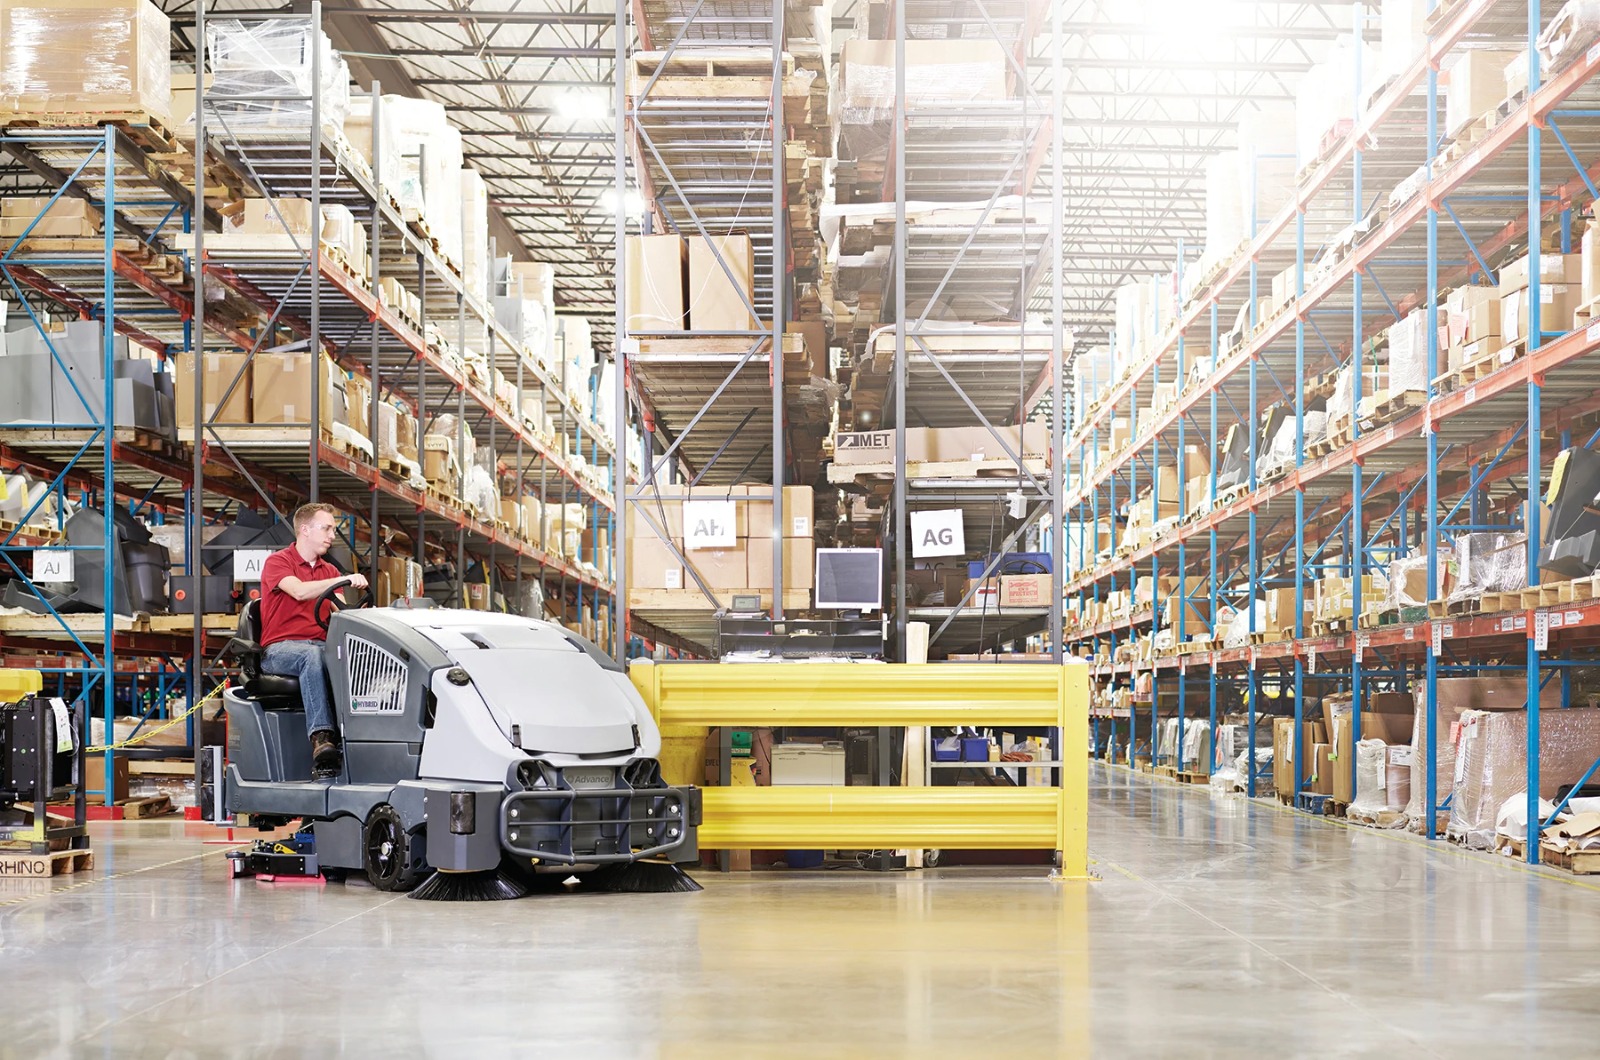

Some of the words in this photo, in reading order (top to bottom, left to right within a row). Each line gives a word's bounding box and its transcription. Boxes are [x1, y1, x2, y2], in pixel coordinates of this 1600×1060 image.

[860, 434, 890, 446] MET
[923, 528, 953, 546] AG
[44, 561, 60, 575] AJ
[245, 559, 260, 572] AI
